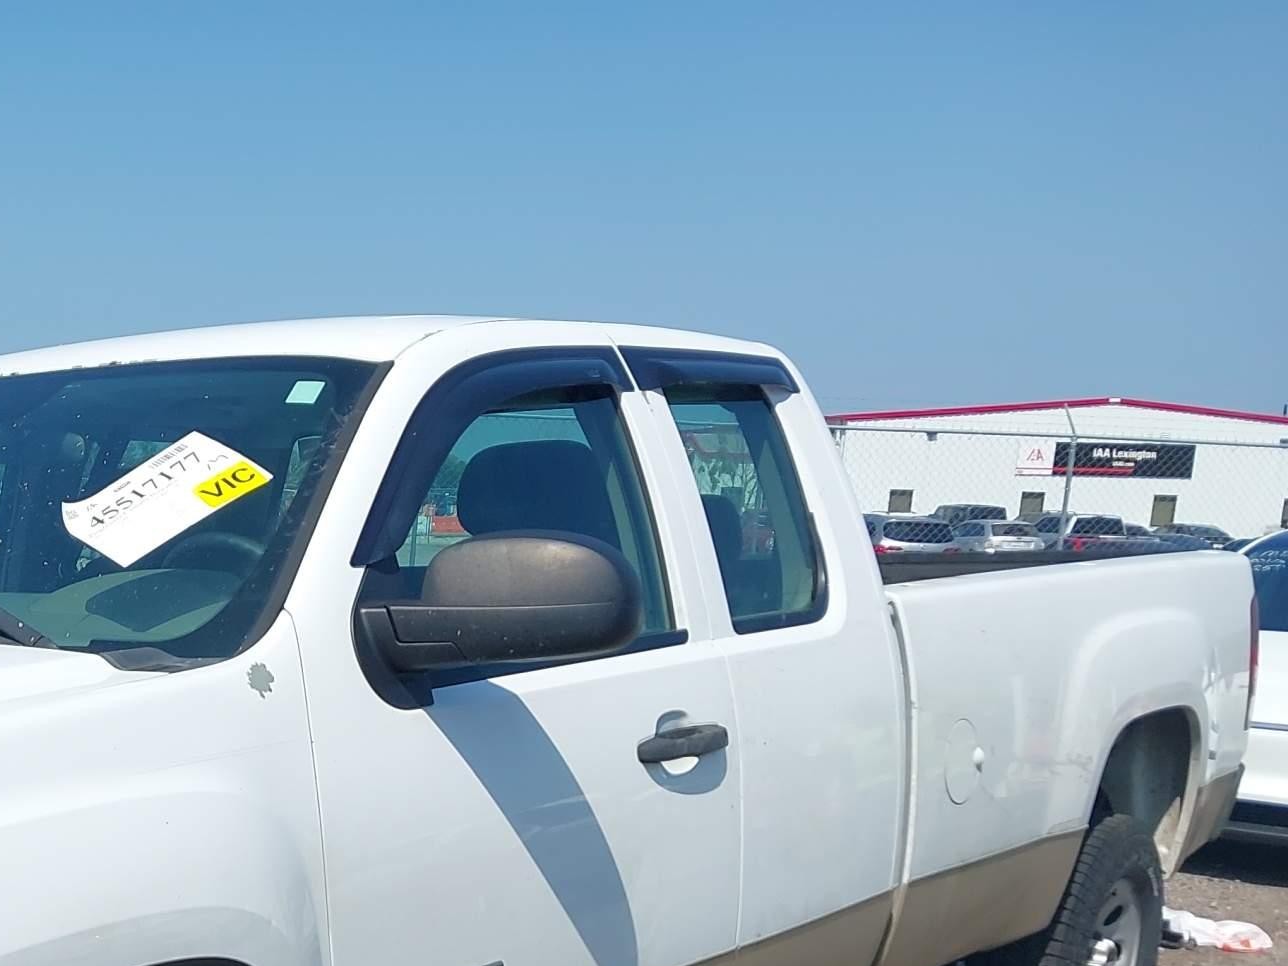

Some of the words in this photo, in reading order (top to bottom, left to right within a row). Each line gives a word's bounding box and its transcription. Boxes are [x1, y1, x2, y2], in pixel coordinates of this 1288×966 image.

[1092, 447, 1111, 458] IAA
[1112, 448, 1157, 461] Lexington
[90, 451, 201, 528] 45517177
[199, 467, 256, 498] VIC
